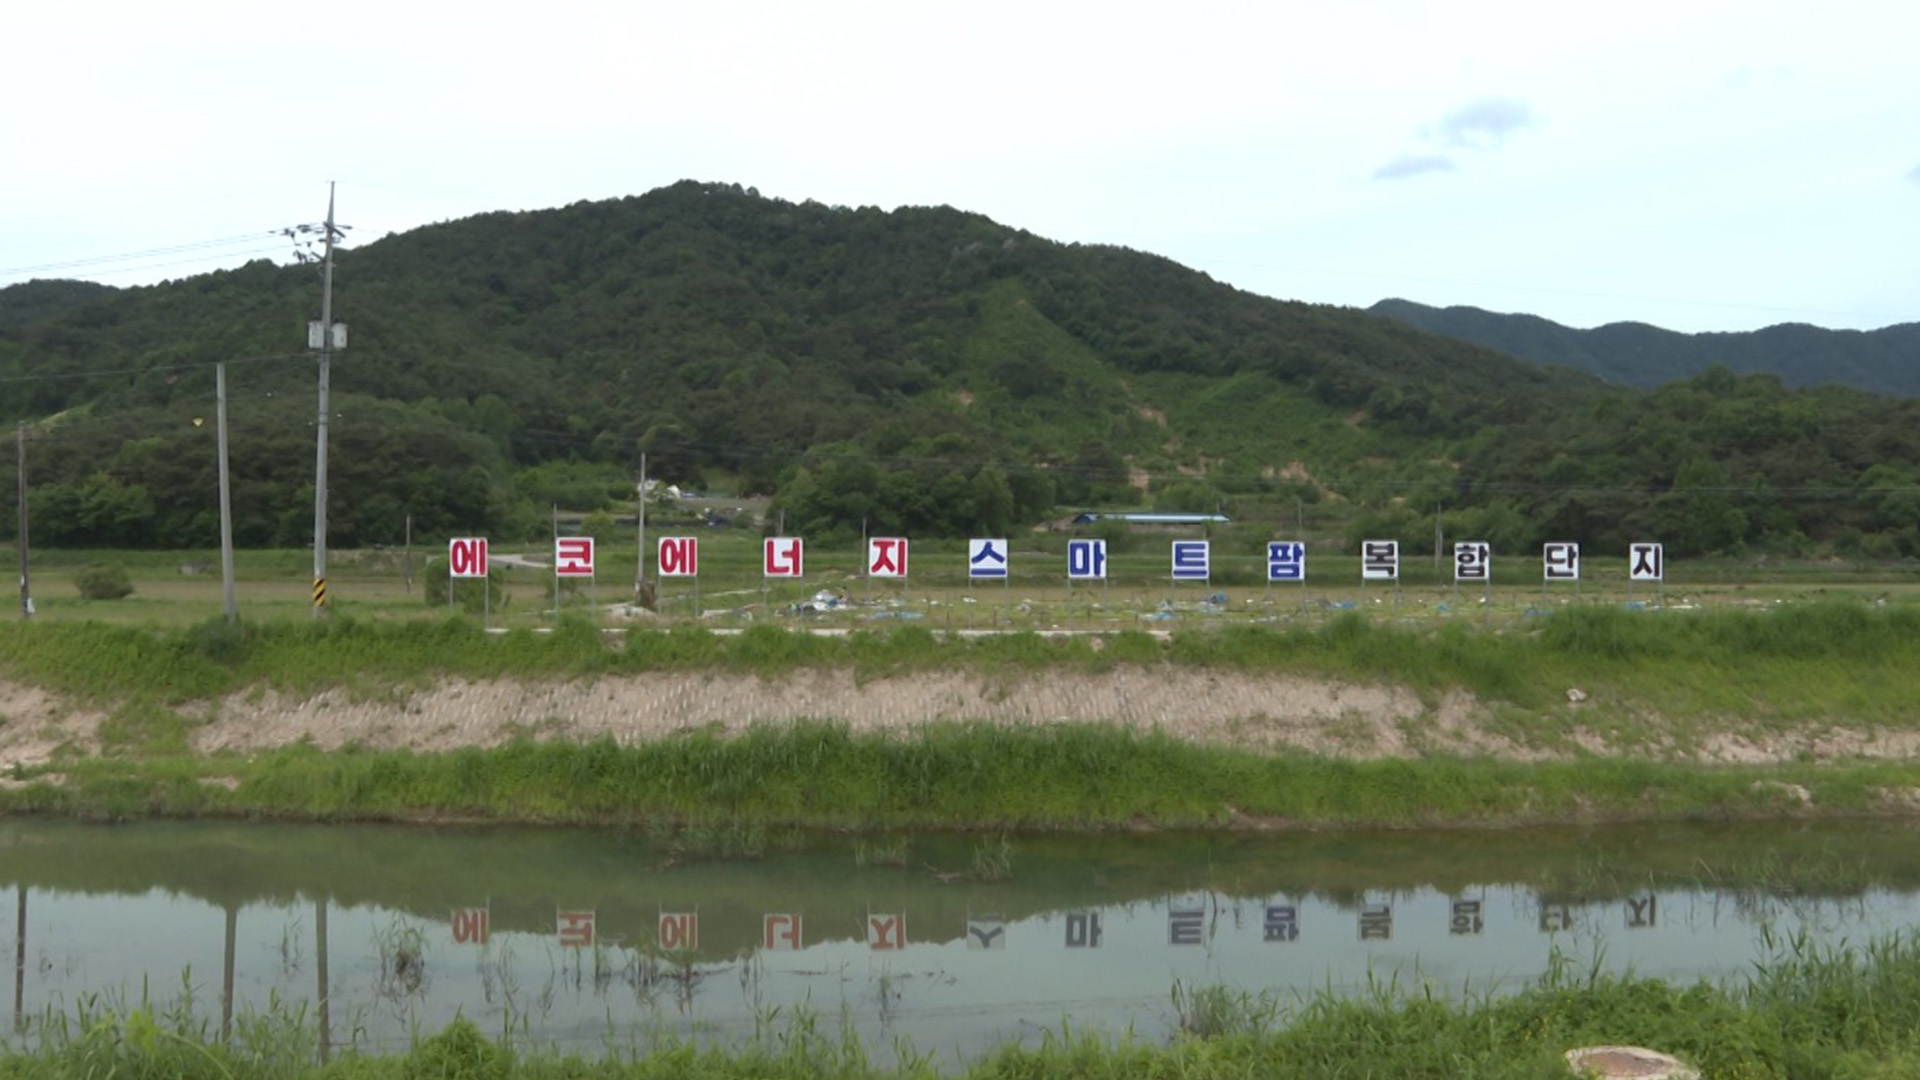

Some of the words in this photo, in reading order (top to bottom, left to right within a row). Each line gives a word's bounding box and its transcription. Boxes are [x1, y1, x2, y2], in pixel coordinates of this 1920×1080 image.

[451, 540, 486, 574] 에
[557, 541, 592, 574] 코
[660, 540, 696, 574] 에
[766, 540, 800, 574] 너
[872, 541, 906, 575] 지
[970, 541, 1007, 576] 스
[1070, 542, 1104, 576] 마
[1174, 543, 1207, 577] 트
[1269, 545, 1303, 577] 팜
[1365, 544, 1397, 576] 복
[1457, 545, 1488, 577] 합
[1545, 545, 1577, 577] 단
[1631, 546, 1661, 578] 지
